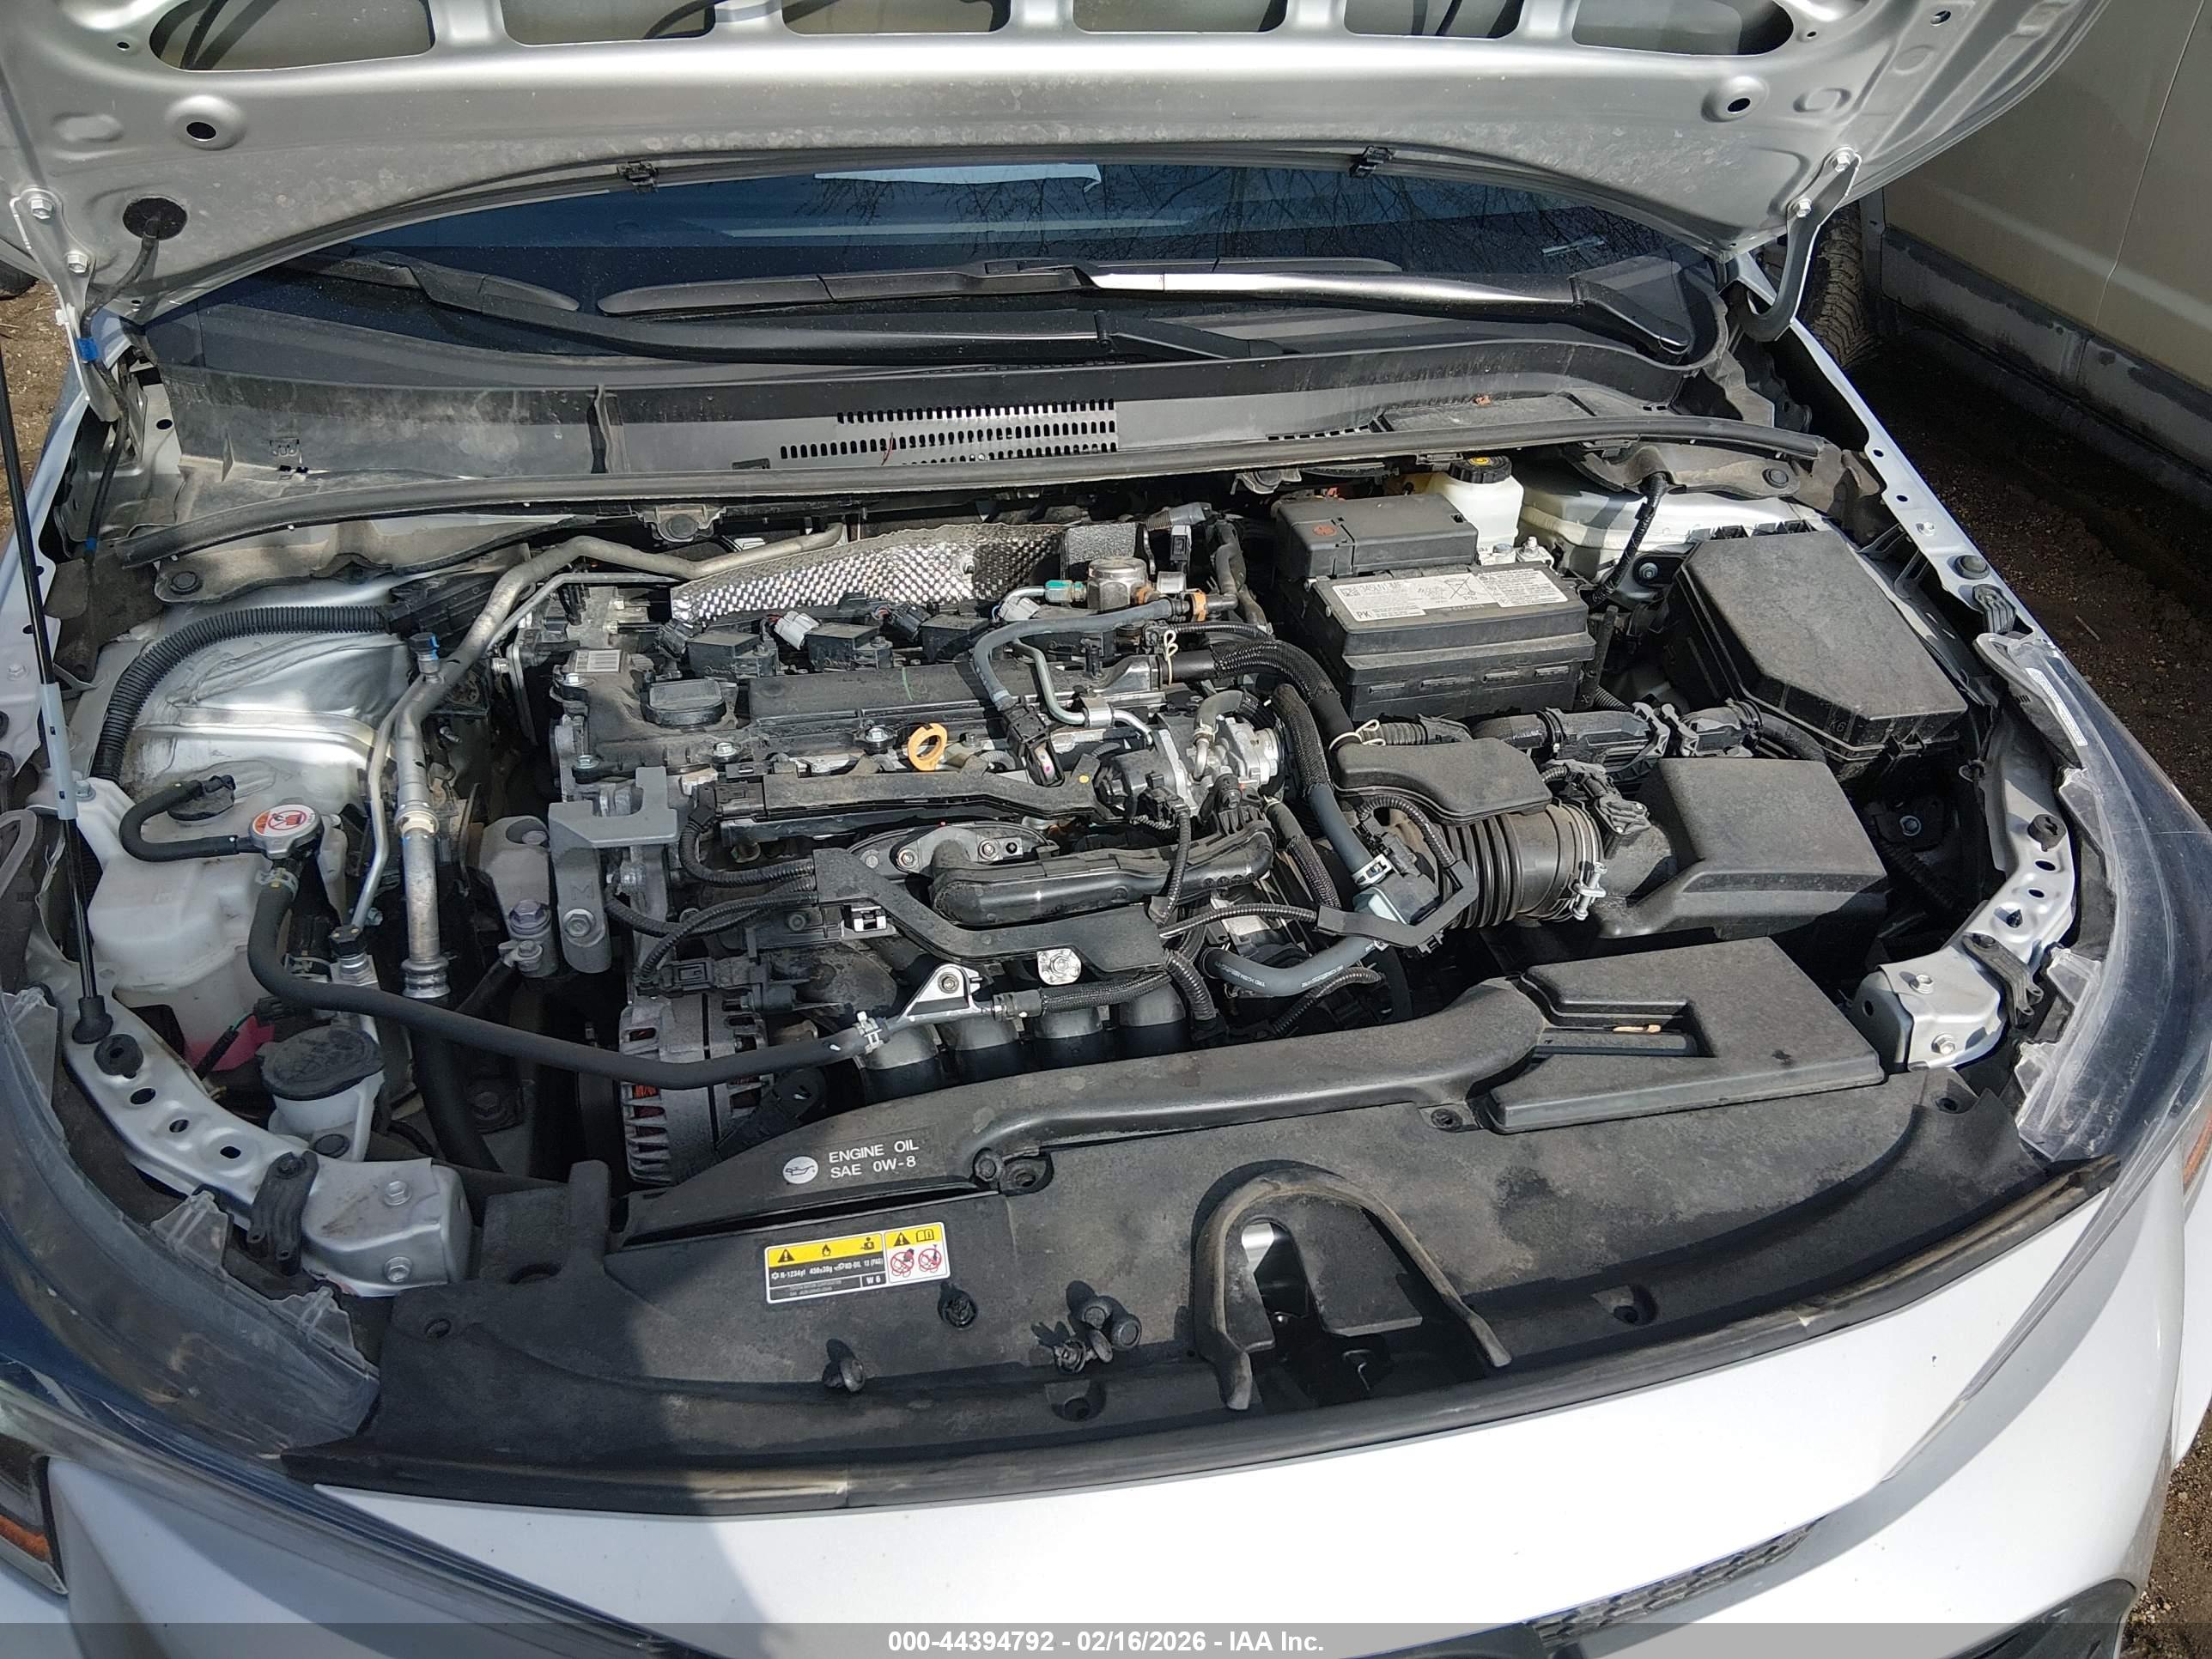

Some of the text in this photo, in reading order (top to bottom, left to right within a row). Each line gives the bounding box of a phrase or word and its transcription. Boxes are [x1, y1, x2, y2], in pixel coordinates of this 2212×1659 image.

[1357, 611, 1372, 619] PK
[829, 1139, 920, 1164] ENGINE OIL
[830, 1155, 916, 1178] SAE 0W-8
[780, 1269, 805, 1279] R-1234yf
[866, 1276, 874, 1285] W
